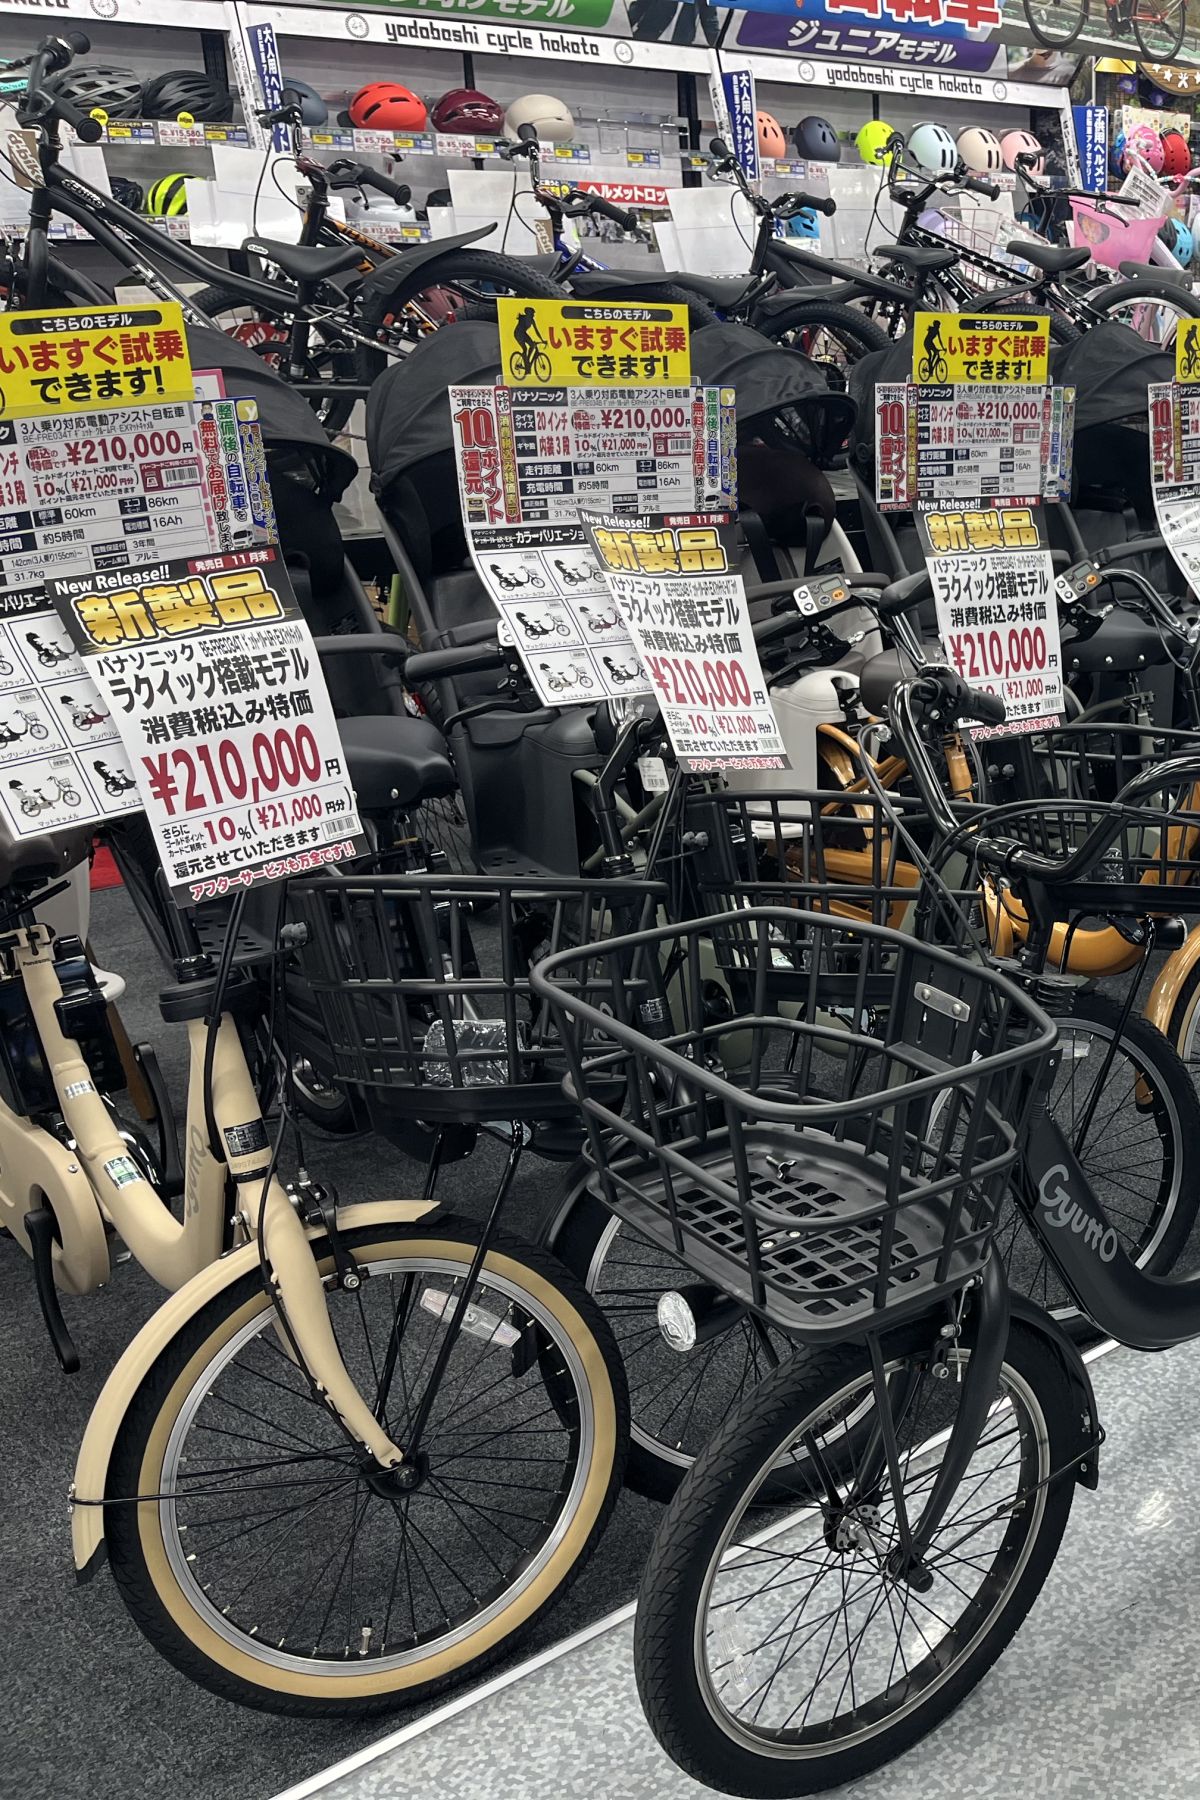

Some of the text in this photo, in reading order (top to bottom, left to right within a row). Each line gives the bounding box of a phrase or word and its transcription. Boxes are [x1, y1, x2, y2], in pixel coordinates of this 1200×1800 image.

[385, 21, 479, 45] yodobashi
[487, 29, 533, 52] cycle
[787, 19, 957, 64] ジュニアモデル
[826, 64, 894, 86] yodobashi
[900, 73, 934, 94] cycle
[739, 73, 755, 180] 大人用ヘルメット
[586, 183, 668, 204] ヘルメットロッ
[41, 313, 133, 332] こちらのモデル
[584, 308, 651, 320] こちらのモデル
[0, 330, 185, 374] いますぐ試乗
[548, 326, 687, 352] いますぐ試乗
[947, 335, 1046, 358] いますぐ試乗
[572, 355, 669, 380] できます!
[962, 360, 1032, 381] できます!
[31, 366, 165, 404] できます!
[512, 390, 564, 402] パナソニック
[20, 406, 186, 435] 3人乗り対応電動アシスト自転車
[601, 407, 685, 431] ¥210,000
[977, 402, 1038, 420] ¥210,000
[64, 430, 181, 467] ¥210,000
[216, 402, 248, 522] 整備後の自転車を
[524, 464, 562, 475] 走行距離
[481, 449, 504, 524] ポイント
[526, 482, 564, 494] 充電時間
[64, 507, 97, 519] 60km
[148, 496, 179, 508] 86km
[917, 498, 982, 510] New Release!!
[152, 516, 183, 528] 16Ah
[581, 512, 651, 528] New Release!!
[924, 509, 1041, 552] 新製品
[42, 528, 85, 545] 約5時間
[132, 538, 156, 549] 3年間
[515, 528, 585, 544] カラーバリエーショ
[135, 552, 160, 562] アルミ
[592, 525, 729, 577] 新製品
[14, 570, 45, 582] 31.7kg
[195, 559, 224, 572] 発売日
[933, 556, 988, 574] パナソニック
[55, 564, 171, 596] New Release!!
[610, 577, 661, 596] パナソニック
[938, 569, 1049, 604] ラクイック搭載モデル
[73, 568, 284, 646] 新製品
[621, 597, 740, 629] ラクイック搭載モデル
[950, 601, 1047, 628] 消費税込み特価
[640, 628, 742, 654] 消費税込み特価
[949, 625, 1047, 679] ¥210,000
[99, 643, 195, 677] パナソニック
[107, 646, 310, 715] ラクイック搭載モデル
[645, 655, 752, 712] ¥210,000
[139, 688, 315, 746] 消費税込み特価
[141, 722, 323, 817] ¥210,000
[161, 823, 190, 839] さらに
[172, 826, 321, 880] 還元させていただきます
[189, 841, 357, 900] アフターサービスも万全です!!
